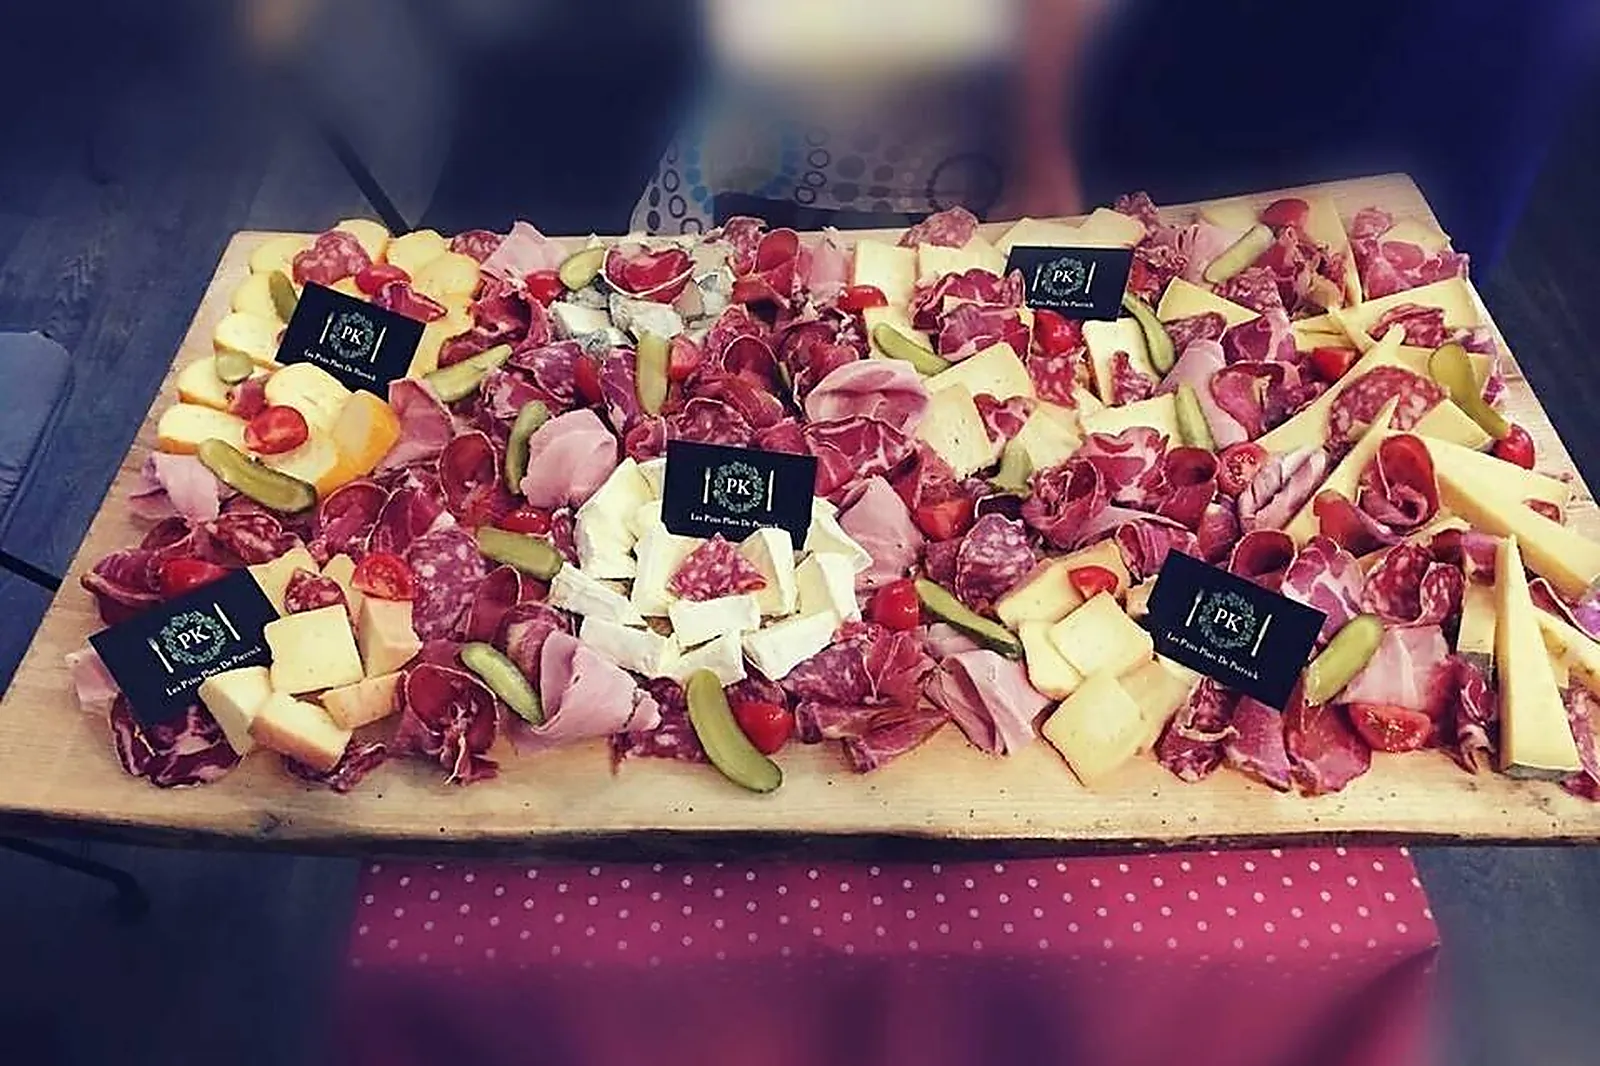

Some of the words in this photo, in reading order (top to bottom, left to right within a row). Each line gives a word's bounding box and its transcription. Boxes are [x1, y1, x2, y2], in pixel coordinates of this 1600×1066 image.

[1053, 270, 1074, 283] PK
[341, 325, 364, 345] PK
[726, 477, 751, 496] PK
[1213, 607, 1244, 633] PK
[177, 625, 211, 650] PK
